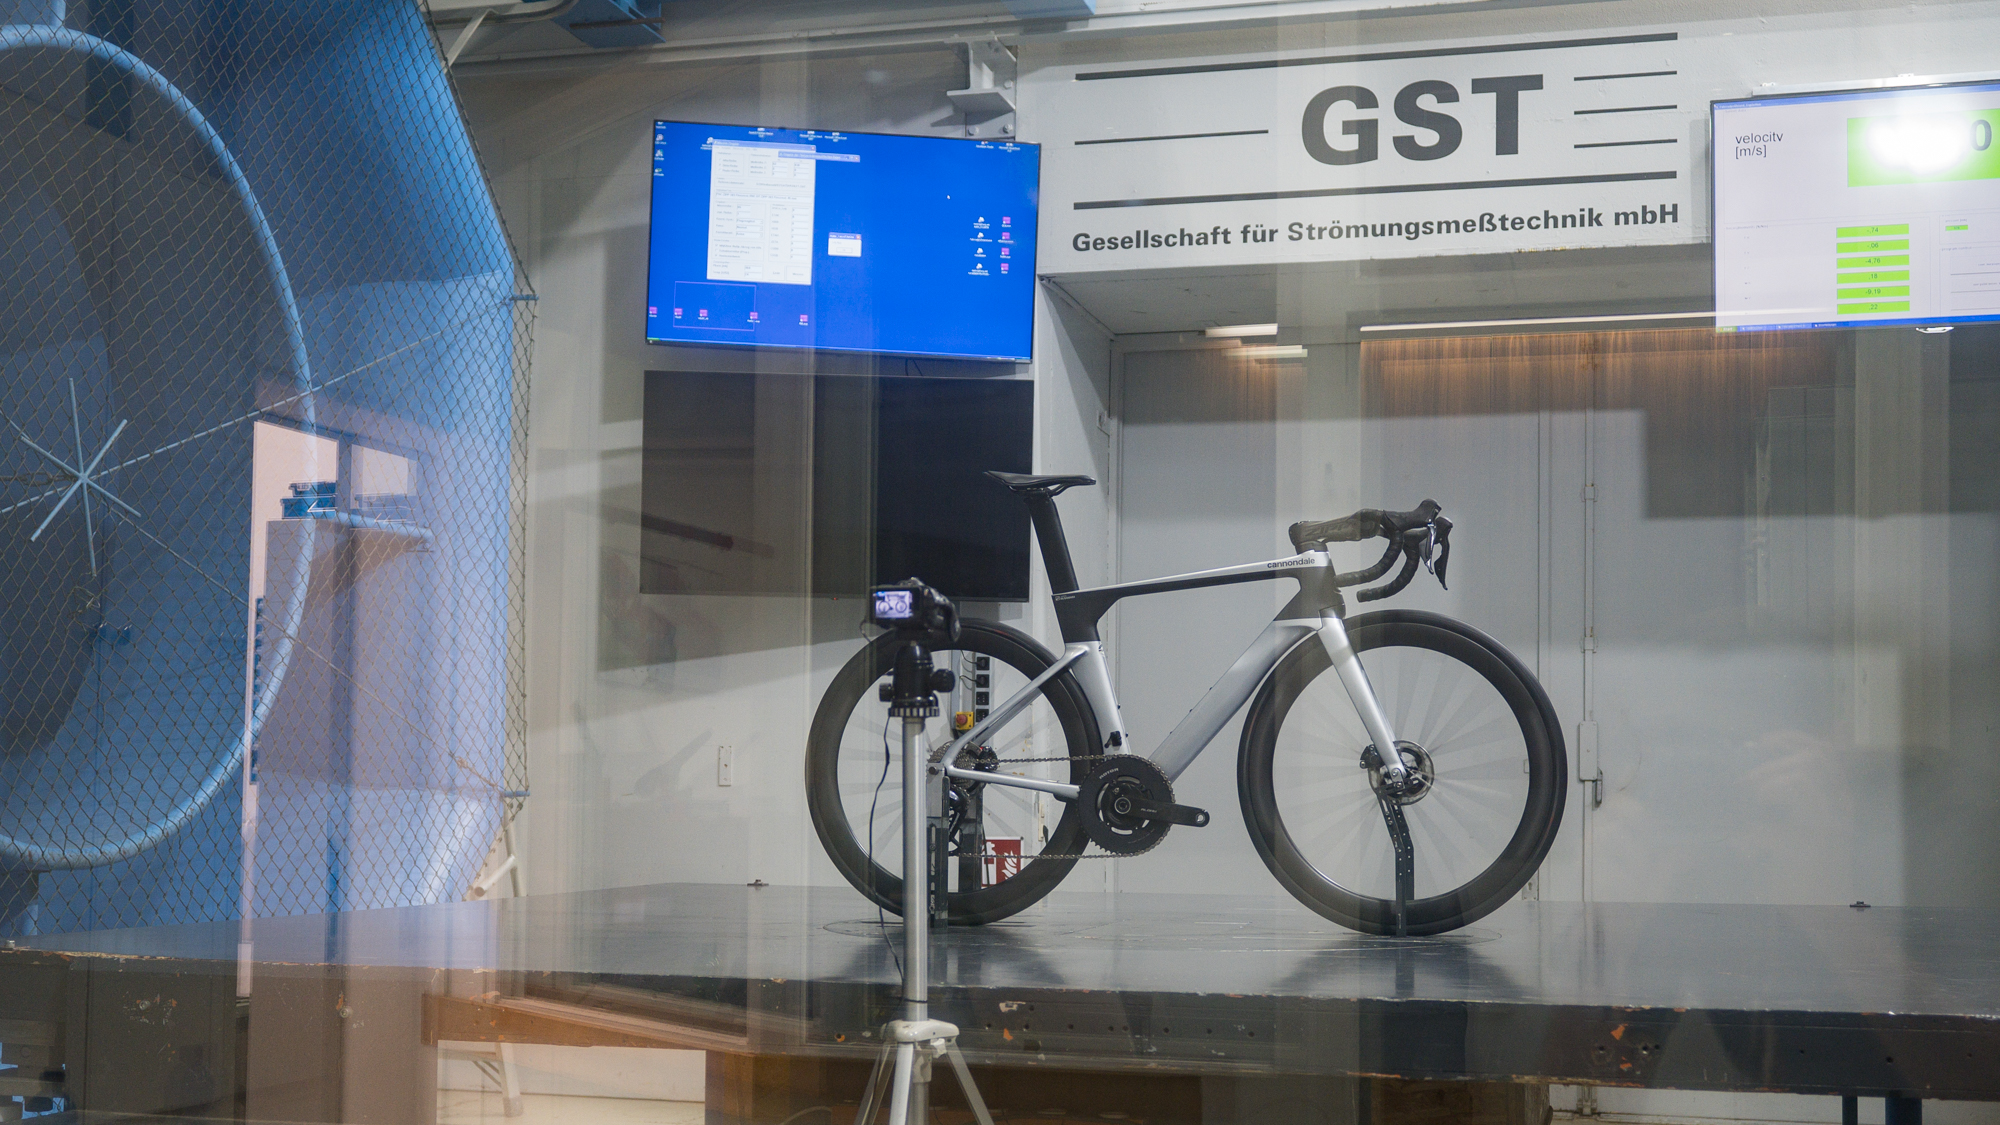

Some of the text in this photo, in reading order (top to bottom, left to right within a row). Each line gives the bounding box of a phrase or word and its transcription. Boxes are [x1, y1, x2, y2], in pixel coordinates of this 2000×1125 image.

[1302, 73, 1544, 166] GST
[1735, 144, 1767, 160] [m/s]
[1071, 203, 1680, 252] Gesellschaft für Strömungsmeßtechnik mbH
[1267, 557, 1315, 568] cannondale
